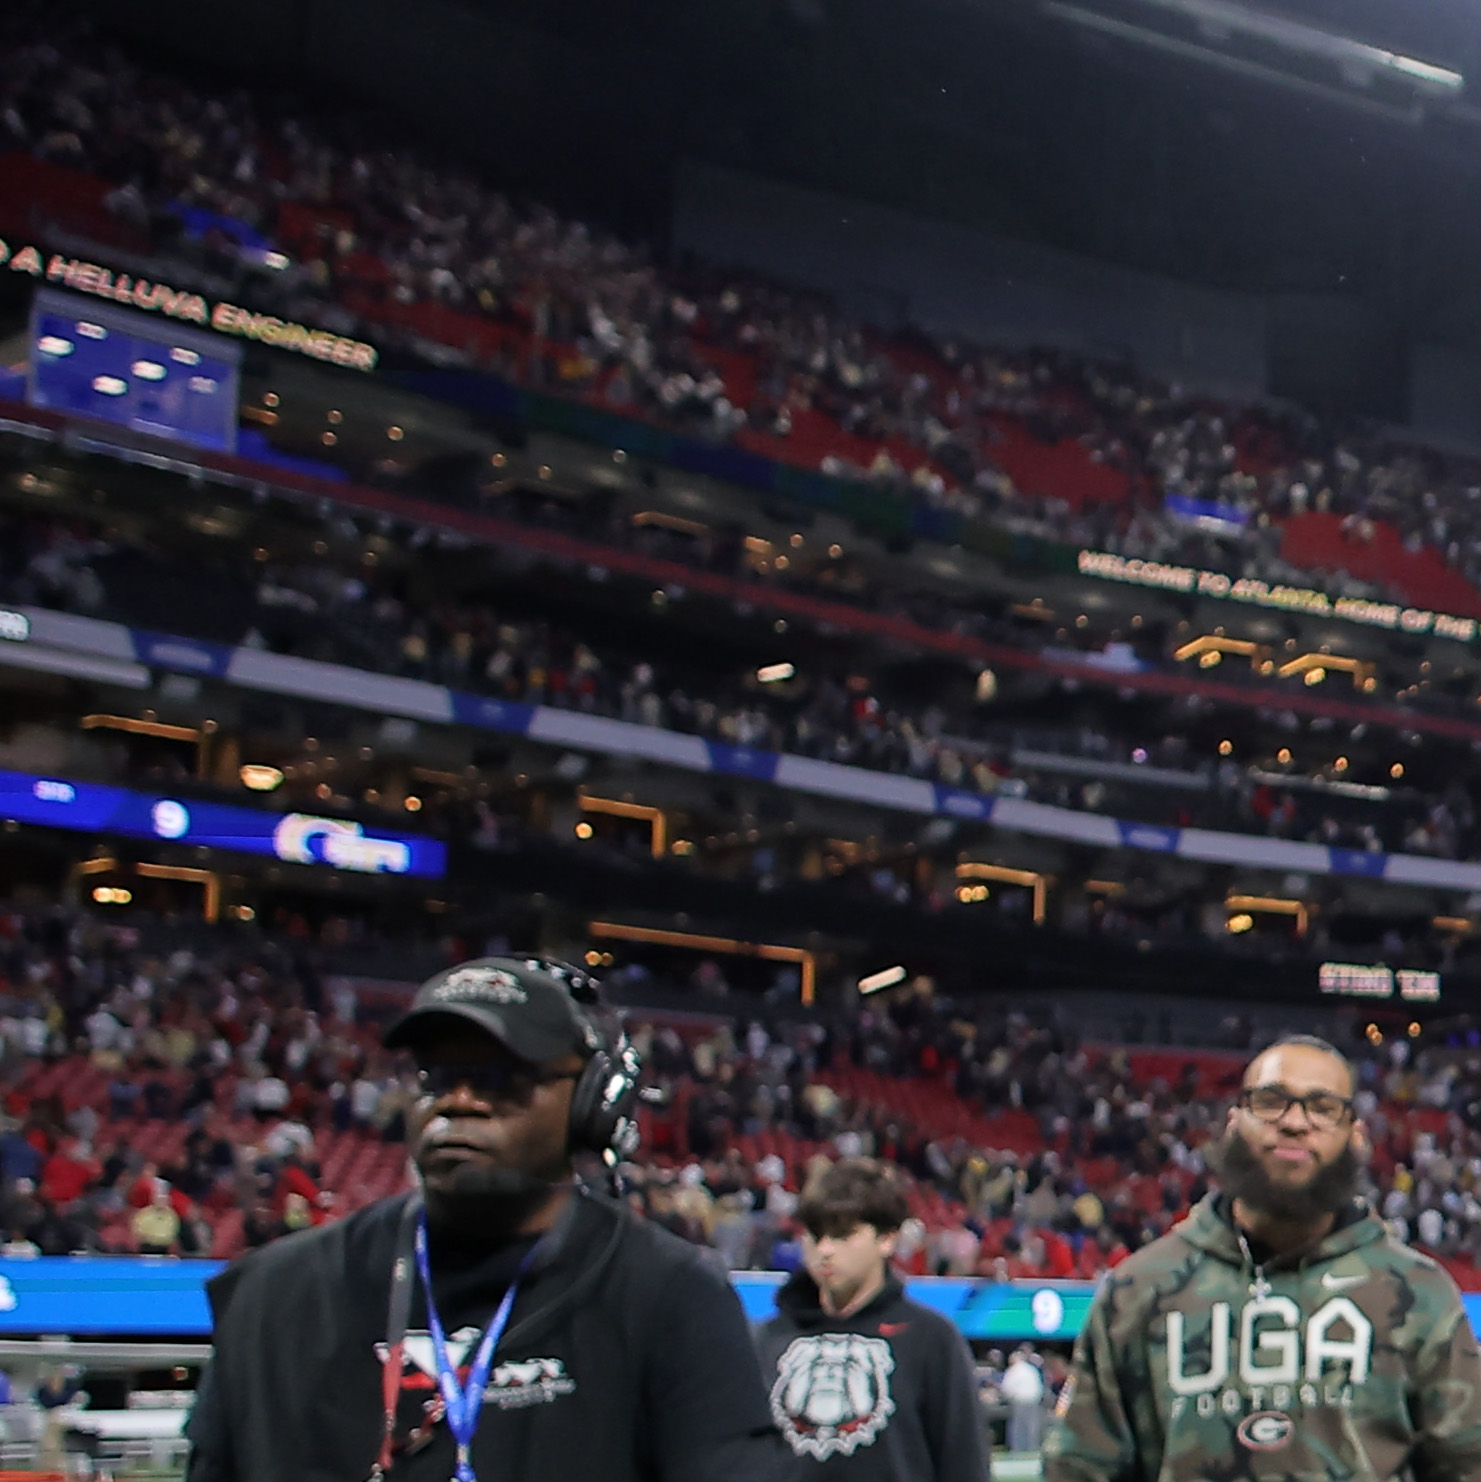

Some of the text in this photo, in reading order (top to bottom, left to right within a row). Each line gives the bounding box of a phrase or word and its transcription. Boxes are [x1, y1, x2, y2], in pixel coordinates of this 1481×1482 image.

[211, 302, 378, 372] ENGINEER
[1199, 568, 1231, 598] TO
[1166, 1296, 1373, 1395] UGA
[1171, 1382, 1354, 1420] FOOTBALL
